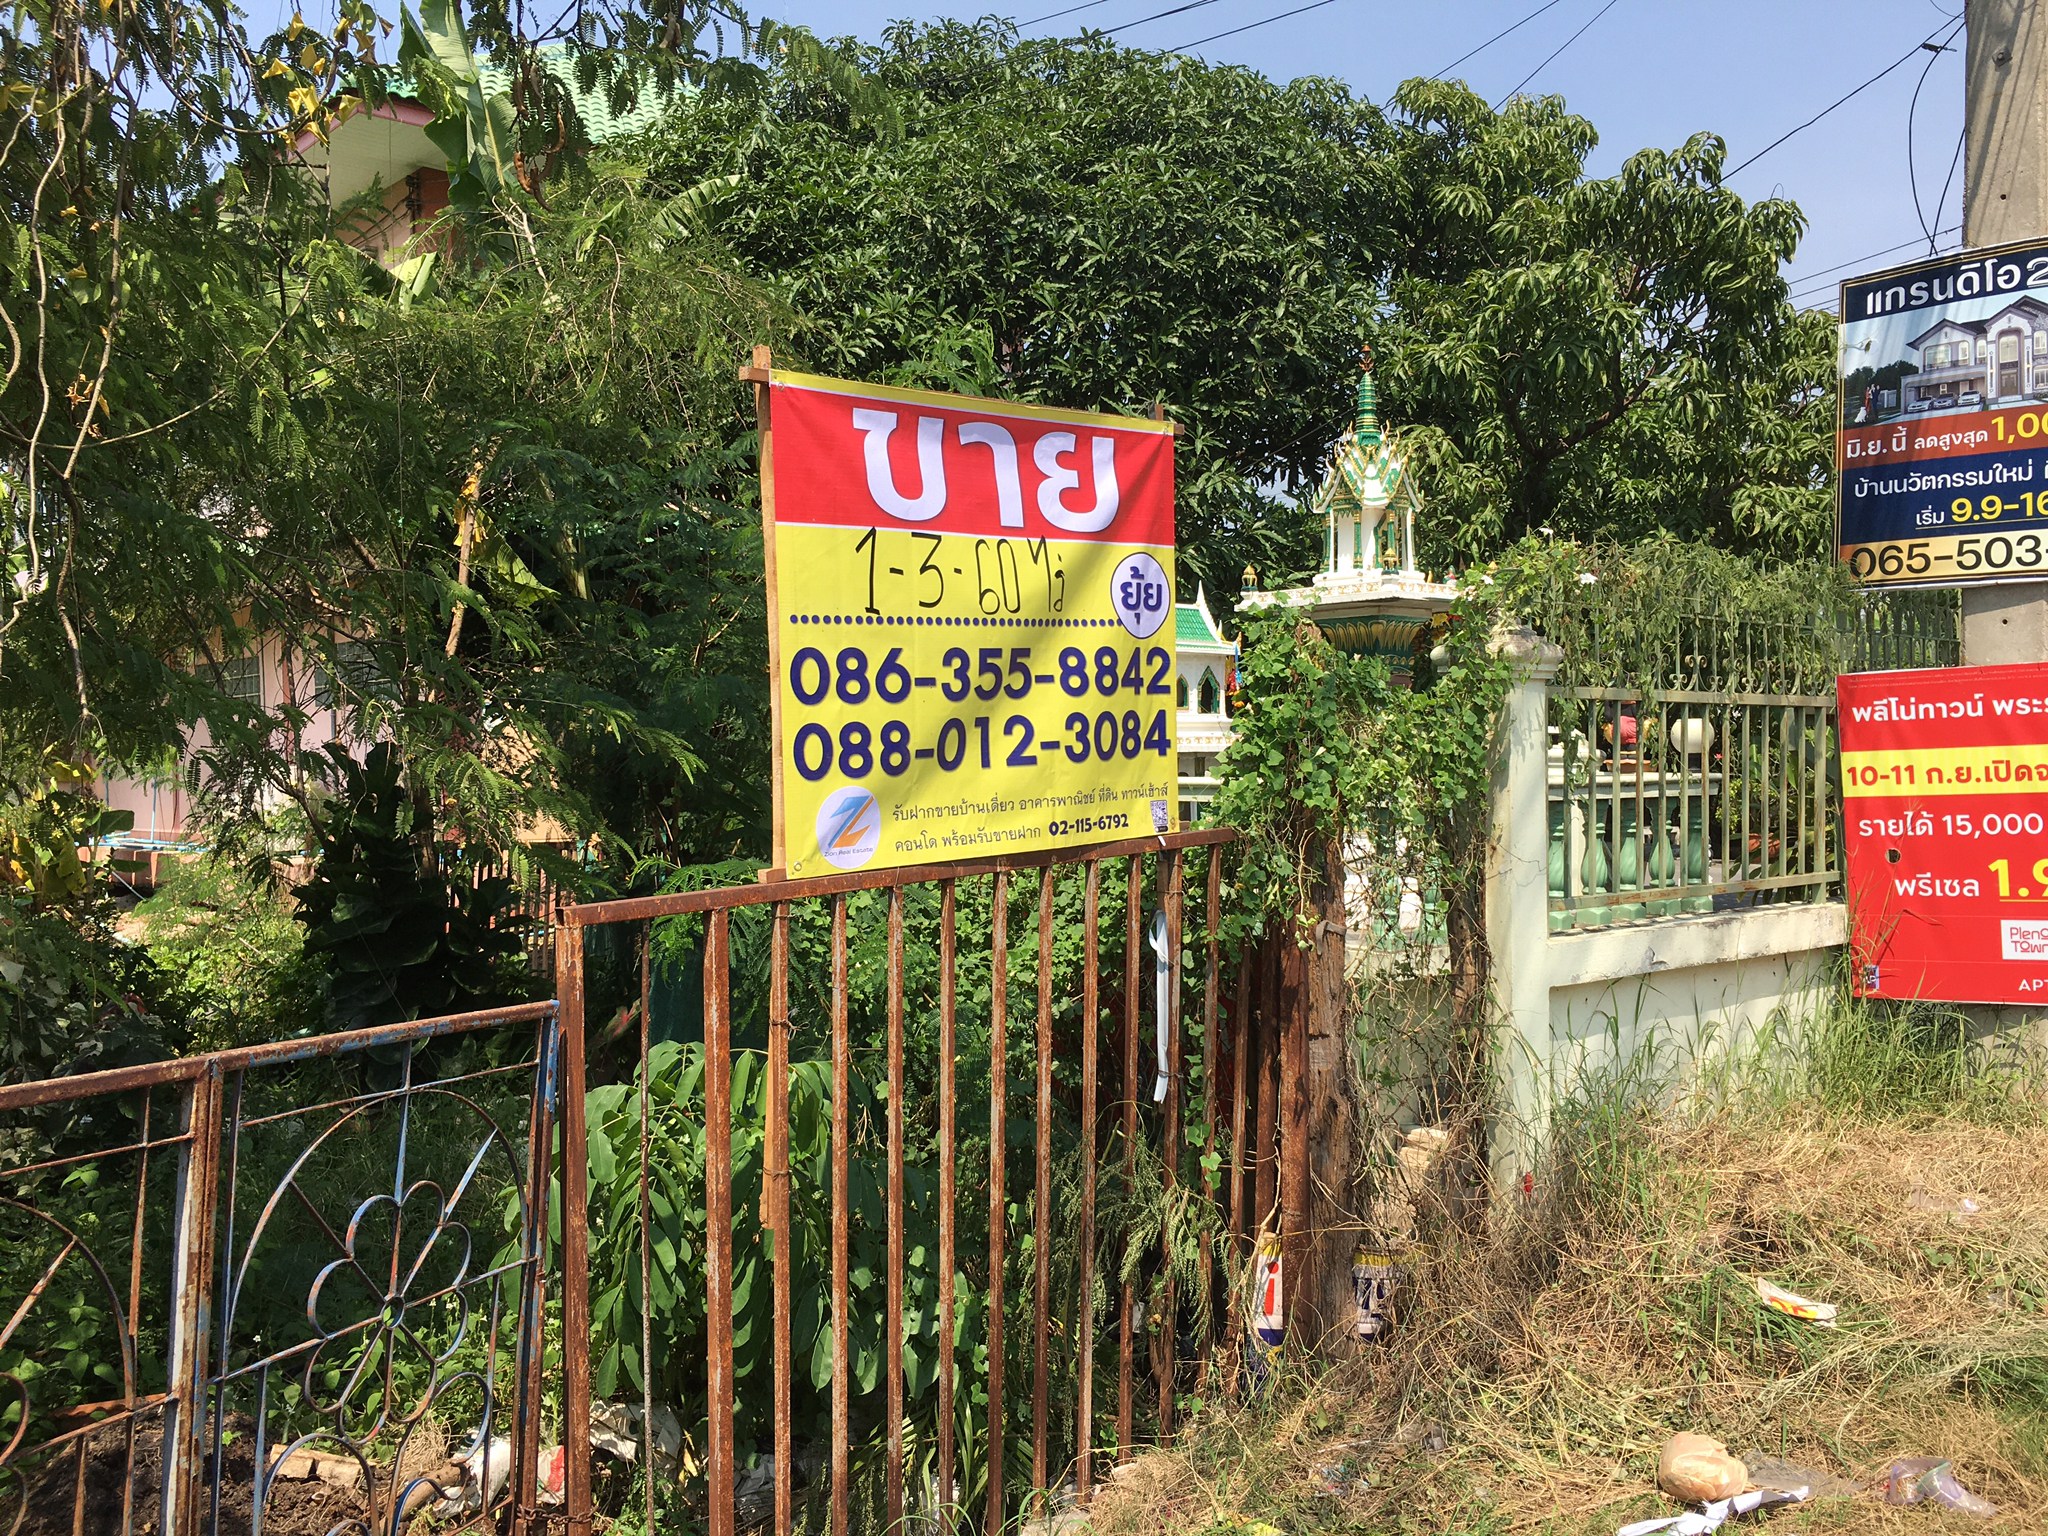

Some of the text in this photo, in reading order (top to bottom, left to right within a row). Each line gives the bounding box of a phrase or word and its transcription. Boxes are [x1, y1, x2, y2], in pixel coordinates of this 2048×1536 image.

[1914, 430, 1989, 451] ลดสูงสุด
[1991, 411, 2048, 444] 1,0
[852, 408, 1120, 533] ขาย
[1854, 459, 2033, 497] บ้านนวัตกรรมใหม่
[1916, 504, 1945, 525] เริ่ม
[1851, 534, 2048, 579] 065-503
[1120, 566, 1163, 625] ยุ้ย
[789, 646, 1172, 705] 086-355-8842
[1852, 693, 2048, 723] พลีโน่ทาวน์ พระ
[793, 709, 1172, 782] 088-012-3084
[1847, 764, 1916, 786] 10-11
[893, 781, 1169, 821] รับฝากขายบ้านเดี่ยว อาคารพาณิชย์ ที่ดิน ทาวน์เฮ้าส์
[895, 813, 1129, 852] คอนโด พร้อมรับขายฝาก 02-115-6792
[1859, 811, 2044, 839] รายได้ 15,000
[1895, 872, 1980, 897] พรีเซล
